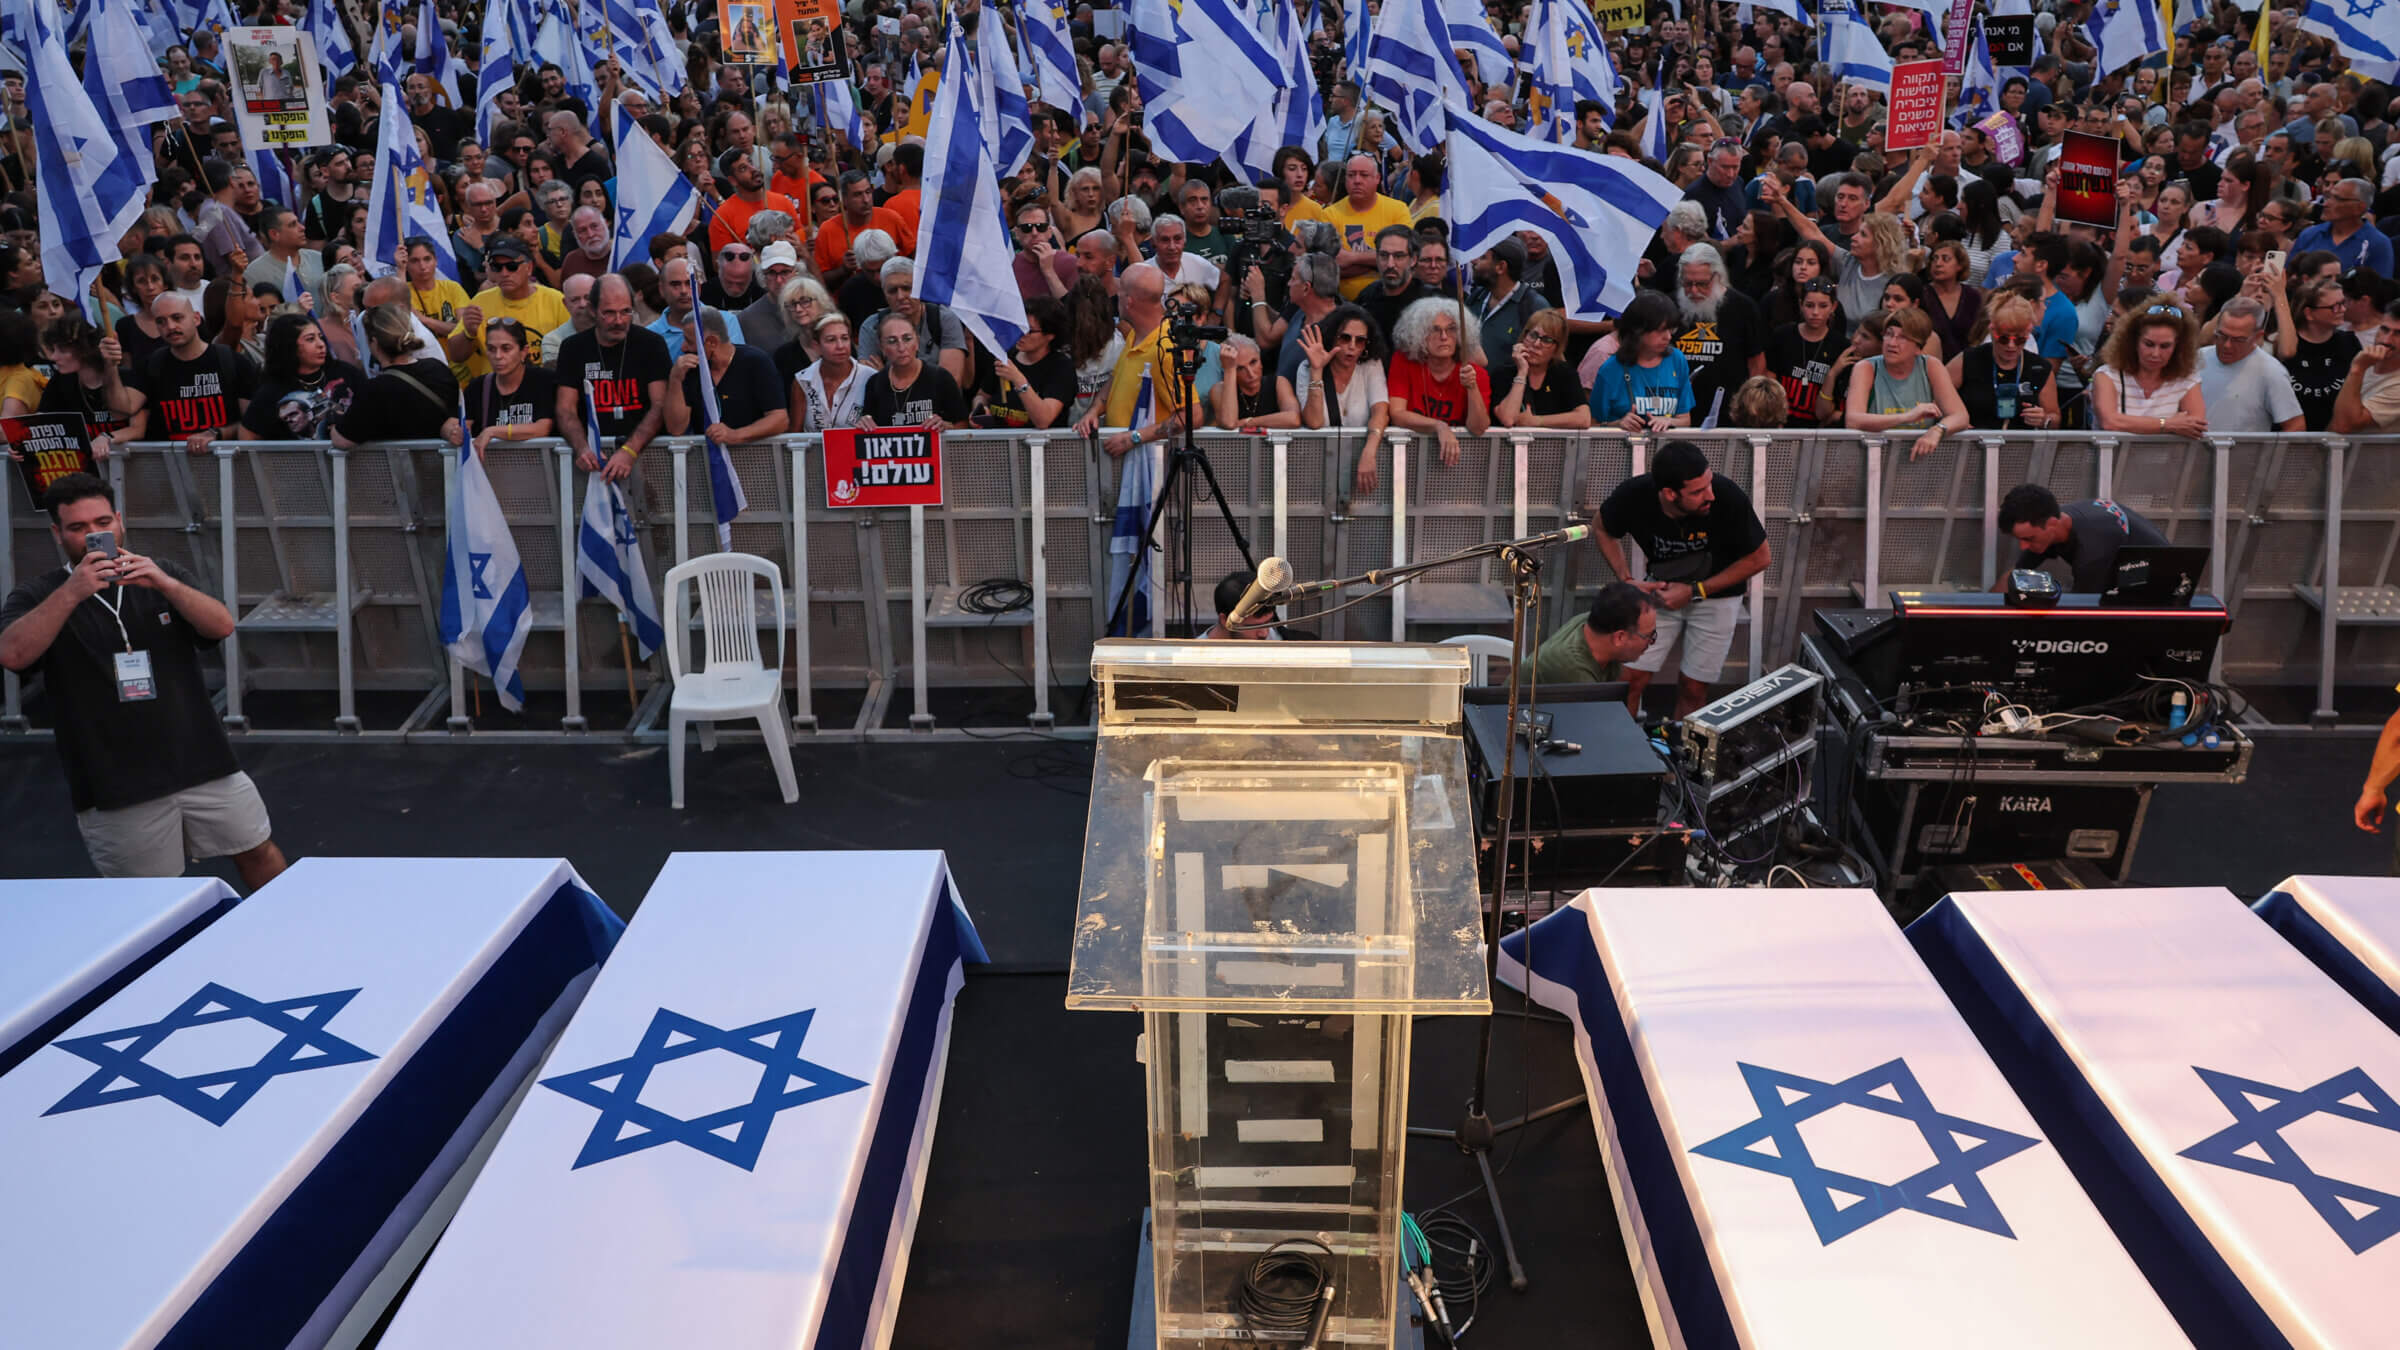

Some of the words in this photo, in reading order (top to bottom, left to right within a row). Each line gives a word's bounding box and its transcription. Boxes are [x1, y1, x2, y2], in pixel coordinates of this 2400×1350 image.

[2008, 26, 2020, 35] מי
[2007, 42, 2024, 52] אם
[1903, 73, 1936, 85] תקווה
[1896, 84, 1939, 97] ונחישות
[1895, 97, 1937, 109] ציבורית
[1898, 110, 1935, 121] משנים
[1894, 120, 1937, 134] מציאות
[29, 424, 65, 438] טרפדת
[23, 437, 63, 452] העסקה
[63, 437, 80, 449] את
[864, 434, 925, 459] לדראון
[861, 460, 931, 485] עולם!
[2000, 796, 2052, 812] KARA
